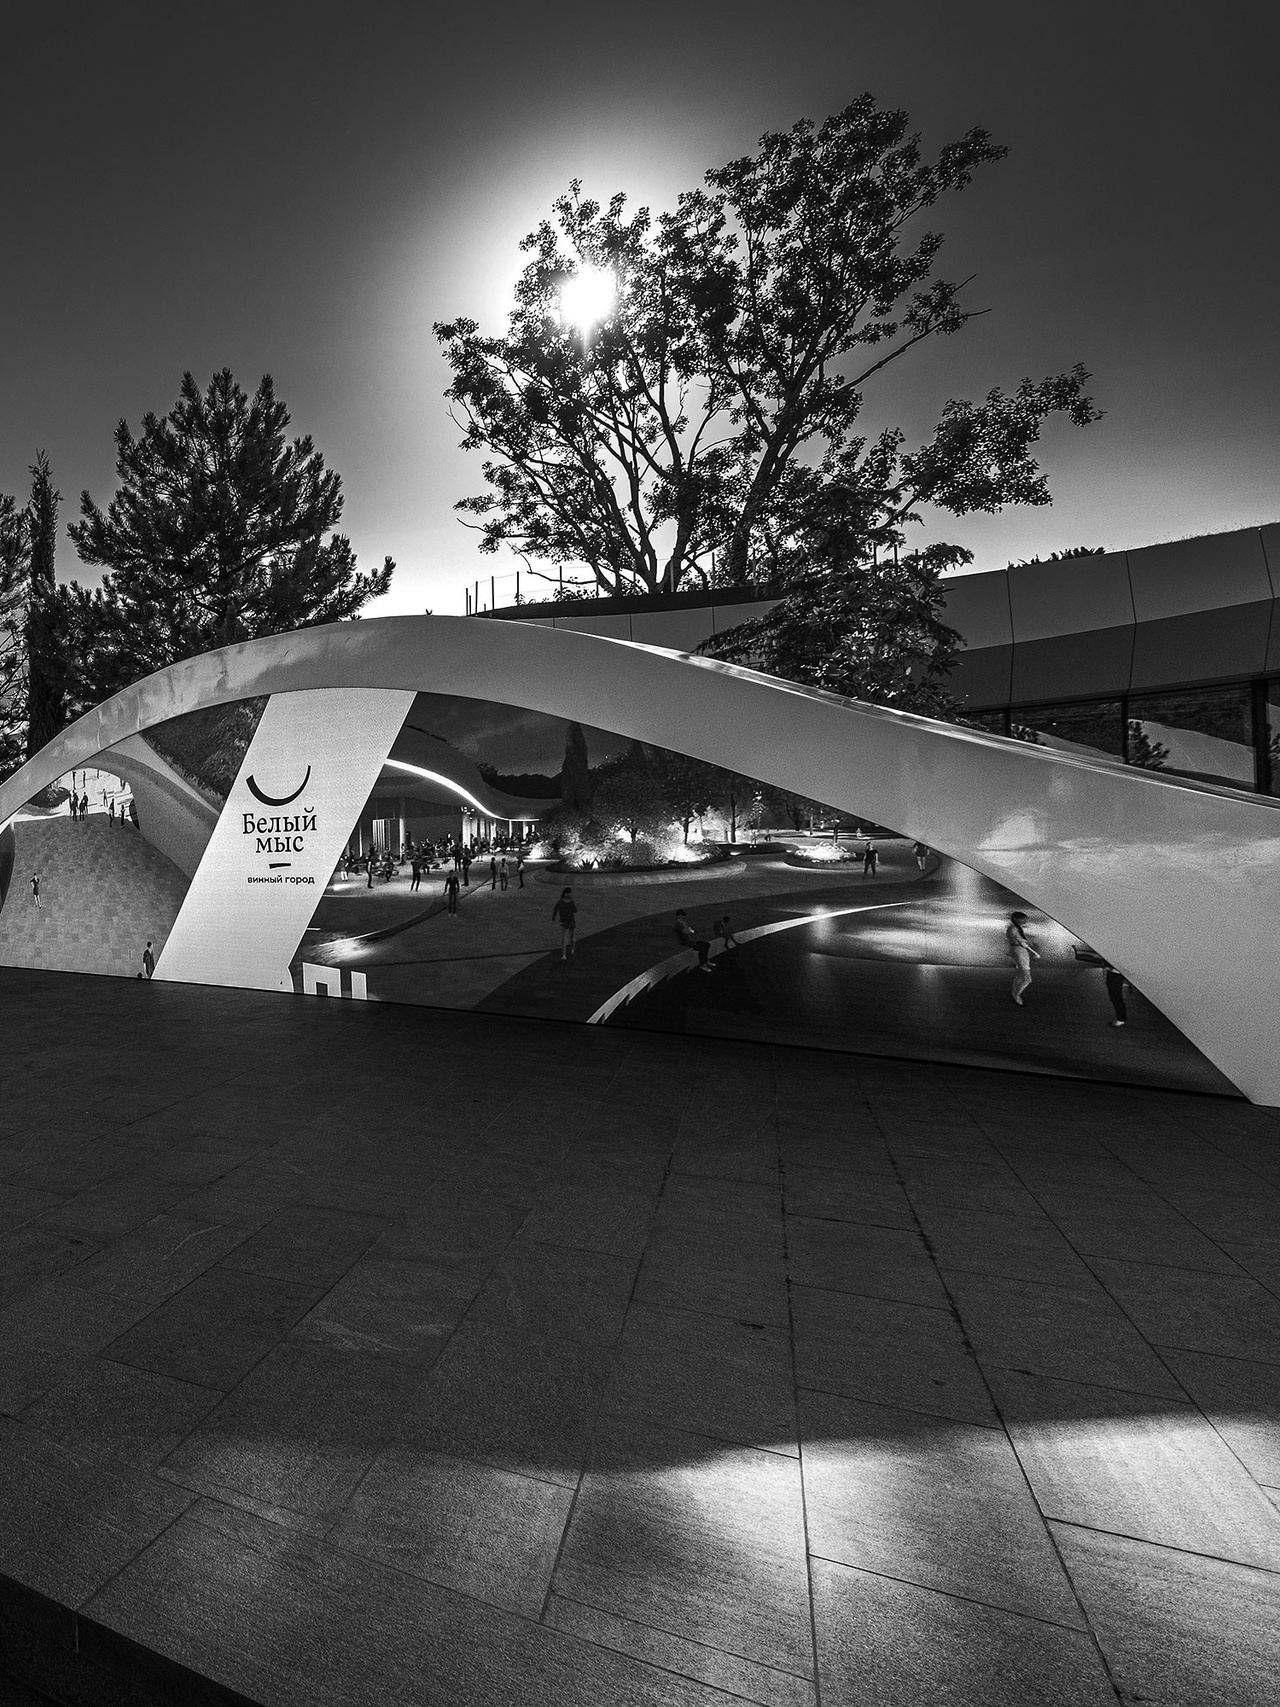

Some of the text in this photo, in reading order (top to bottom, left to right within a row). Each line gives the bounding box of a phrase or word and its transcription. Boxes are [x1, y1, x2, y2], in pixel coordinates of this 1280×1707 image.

[242, 806, 317, 834] Белый
[256, 836, 304, 853] мыс
[247, 875, 315, 885] винный город
